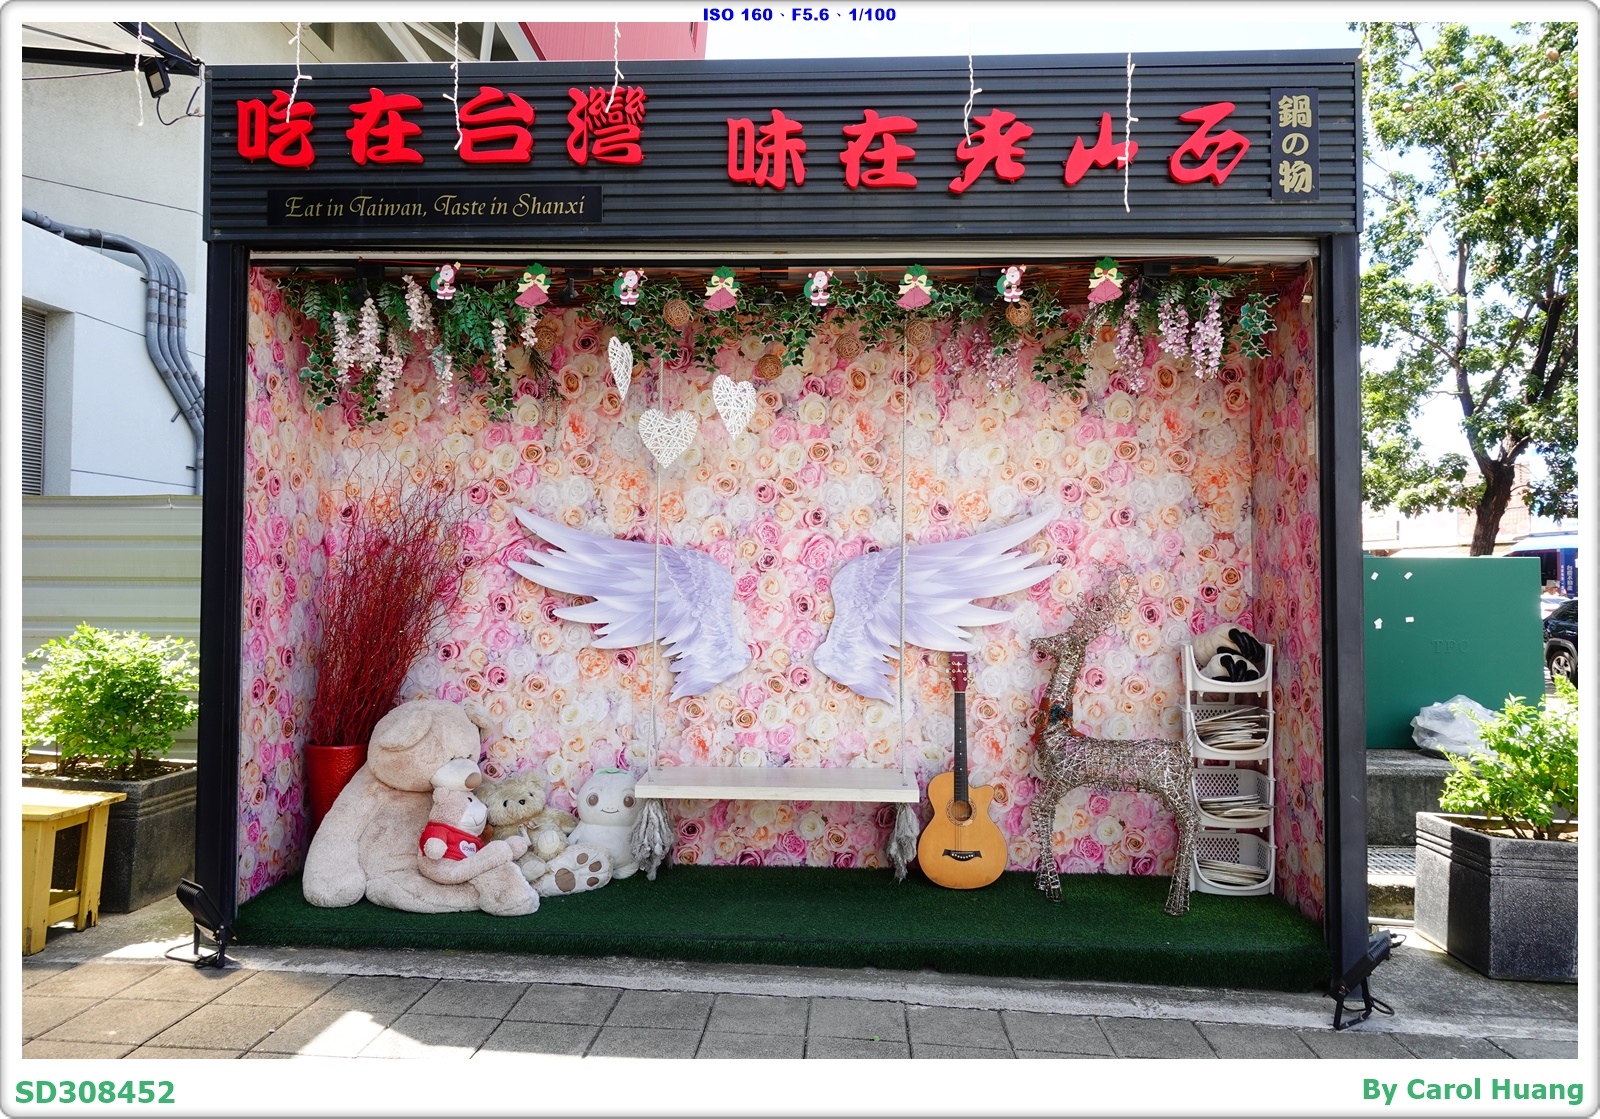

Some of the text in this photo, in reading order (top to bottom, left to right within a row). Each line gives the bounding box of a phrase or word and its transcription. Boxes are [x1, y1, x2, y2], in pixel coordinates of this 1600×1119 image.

[236, 86, 646, 168] 吃在台灣
[1274, 93, 1314, 196] 鍋の物
[285, 193, 585, 217] Eat in Taiwan, Taste in Shanxi
